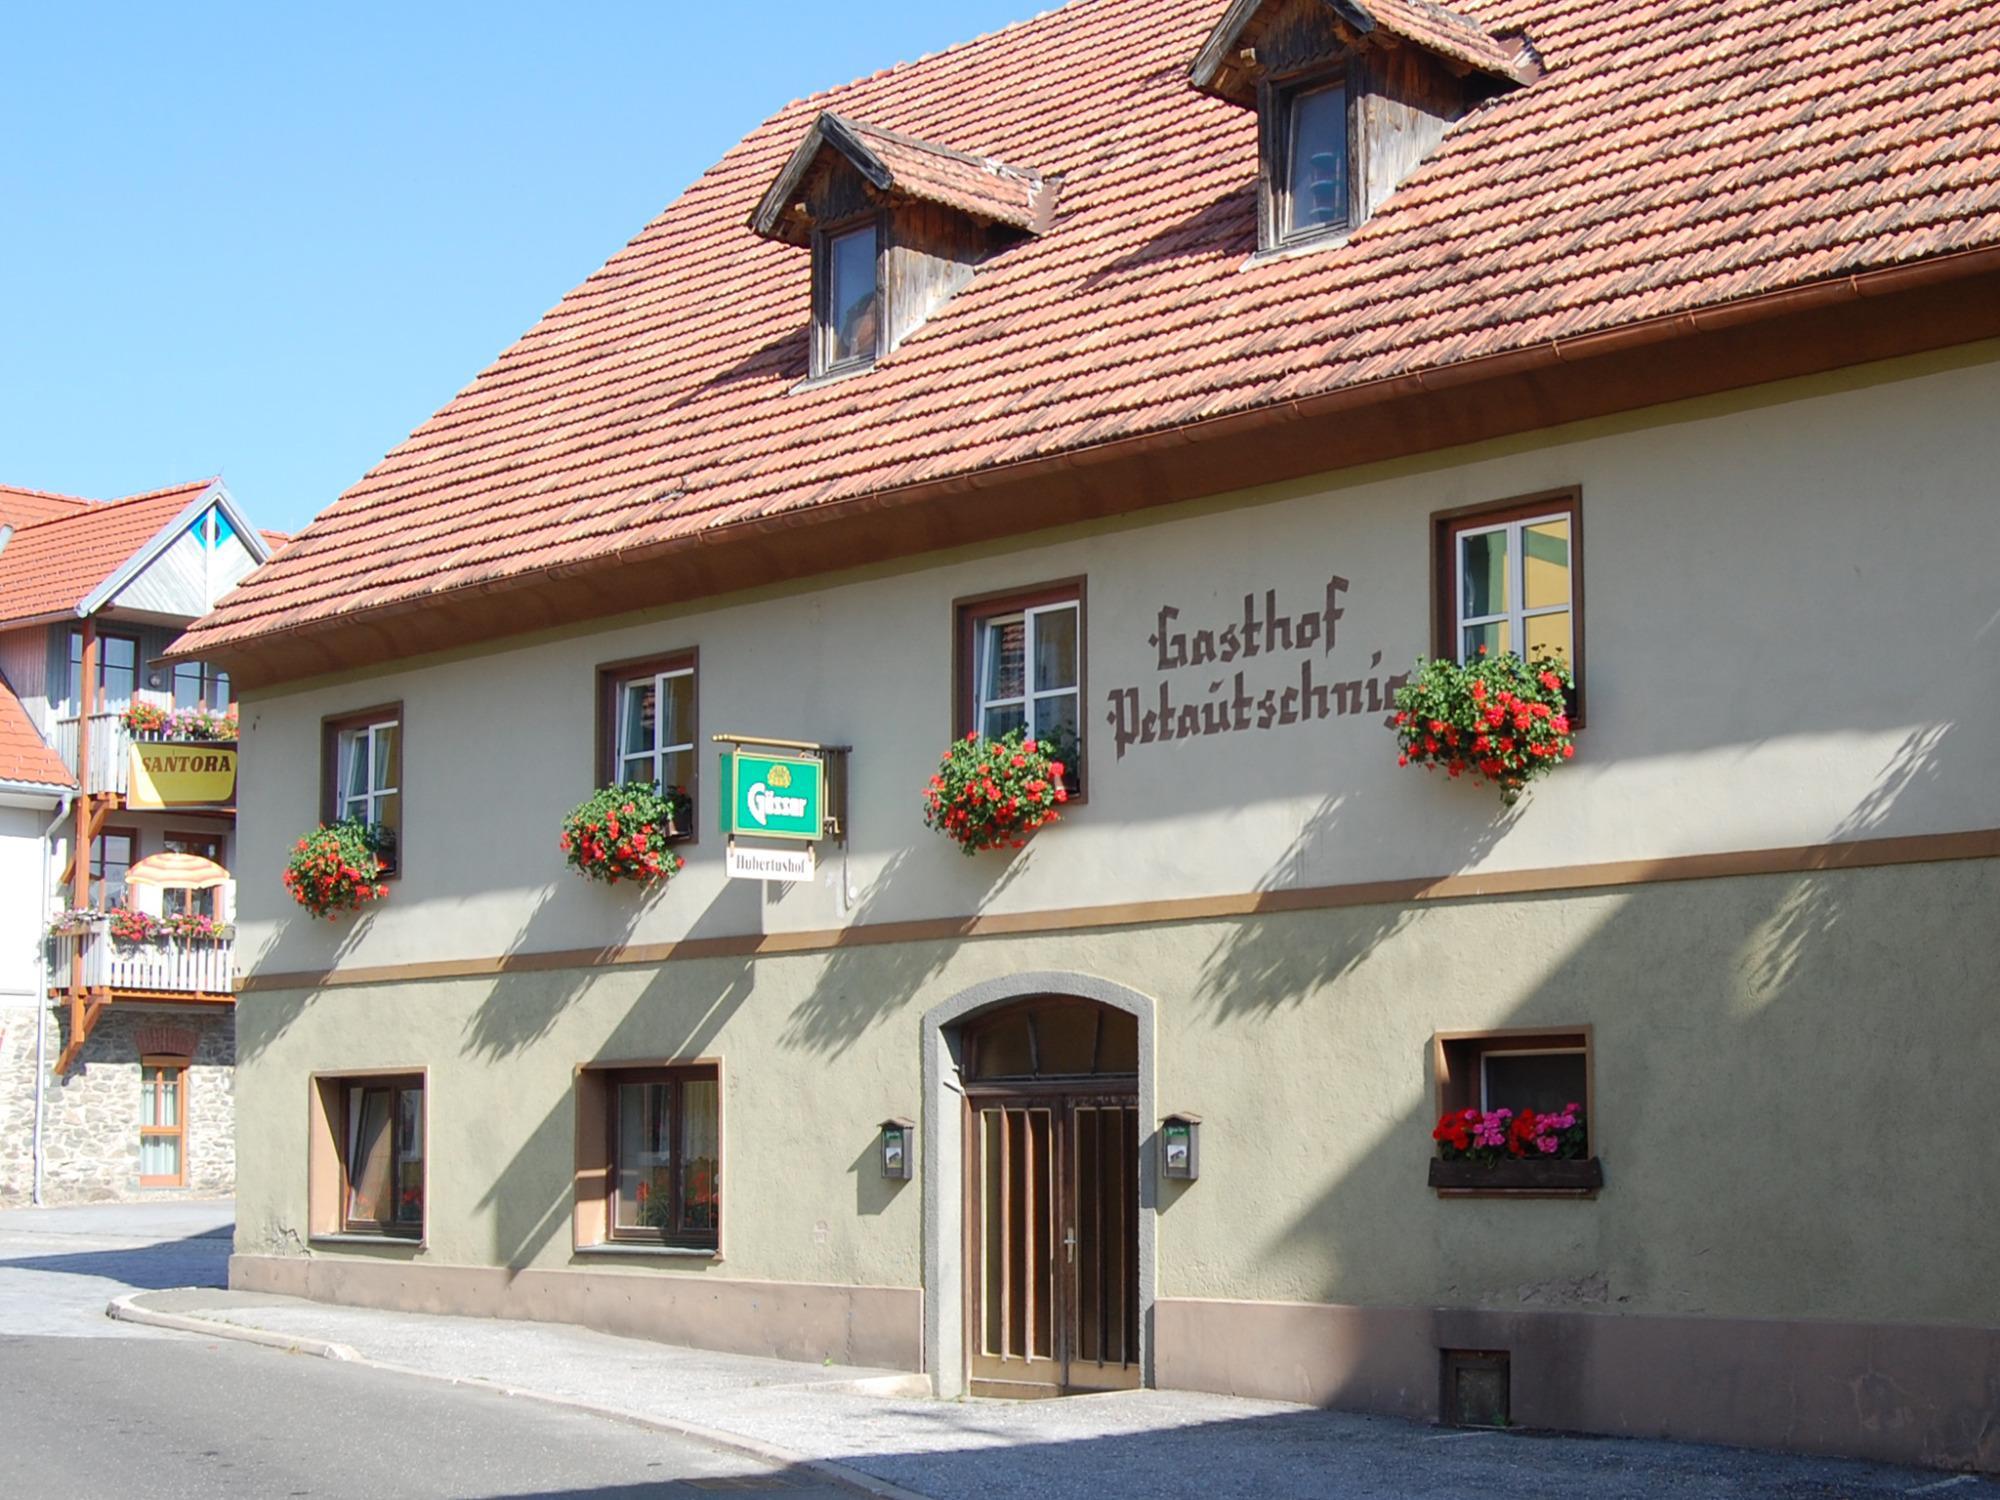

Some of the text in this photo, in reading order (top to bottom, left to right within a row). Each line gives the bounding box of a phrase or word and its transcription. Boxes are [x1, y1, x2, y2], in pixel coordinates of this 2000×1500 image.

[1148, 575, 1349, 671] Gasthof
[142, 755, 231, 773] SANTORA
[736, 853, 805, 873] Hubertushof
